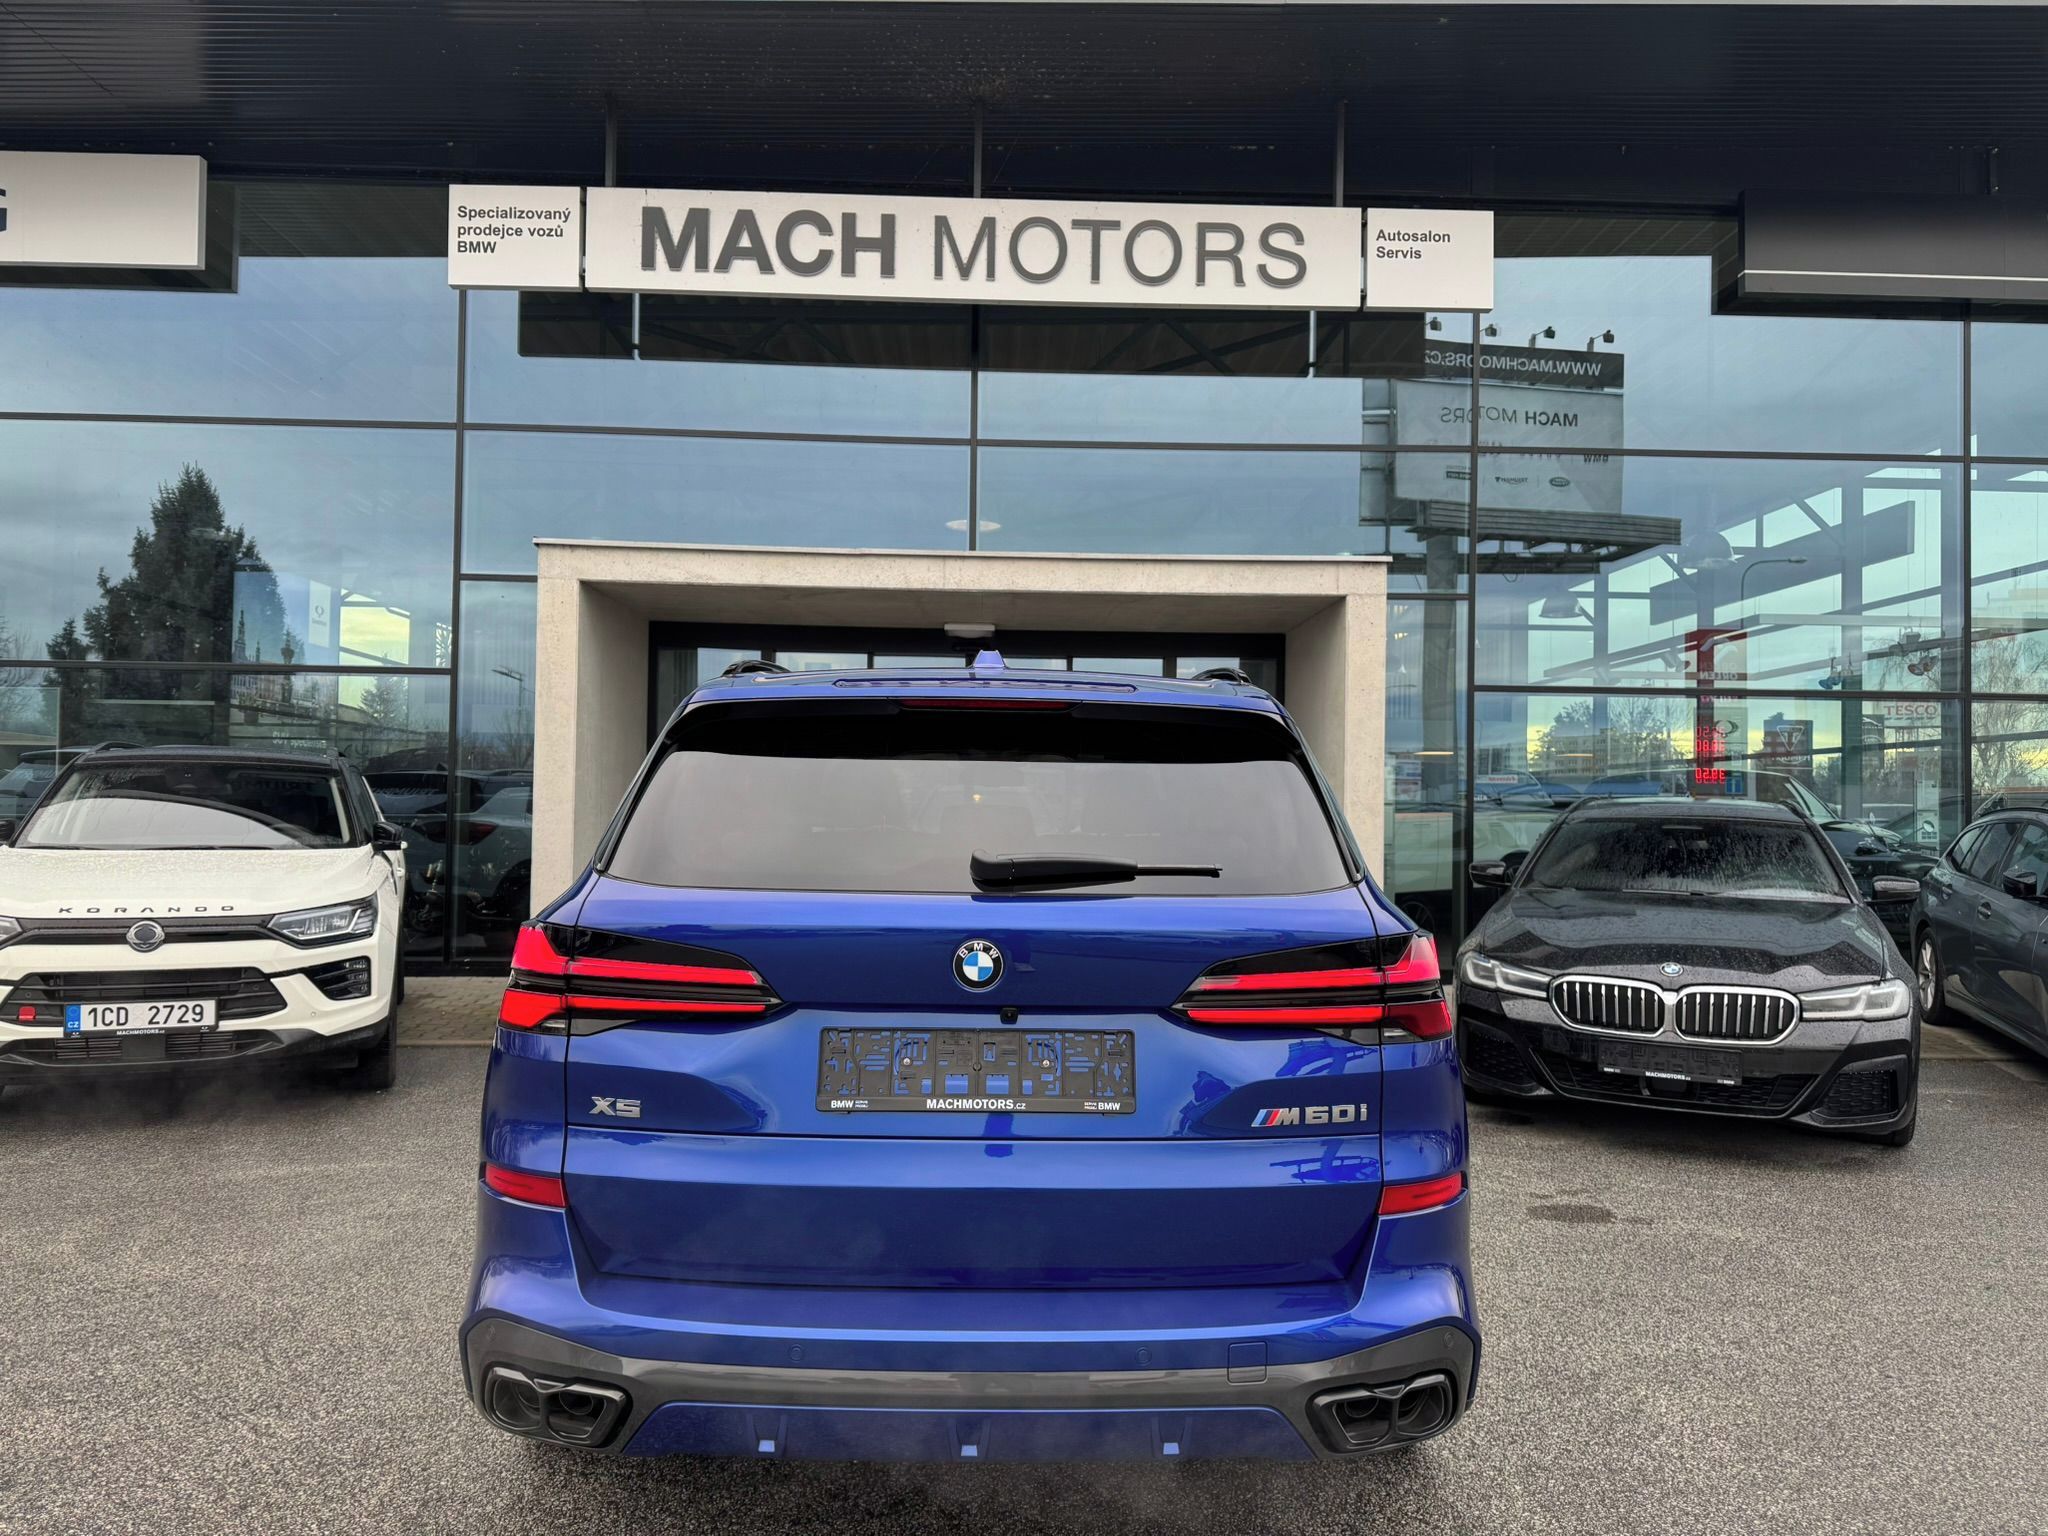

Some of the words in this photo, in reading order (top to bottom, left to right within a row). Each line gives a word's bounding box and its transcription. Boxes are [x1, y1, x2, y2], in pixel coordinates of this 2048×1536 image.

[457, 205, 571, 223] Specializovaný
[457, 224, 523, 239] prodejce
[528, 224, 564, 237] vozů
[1376, 229, 1451, 243] Autosalon
[457, 241, 497, 254] BMW
[640, 206, 896, 277] MACH
[933, 214, 1307, 288] MOTORS
[1376, 246, 1422, 259] Servis
[1883, 704, 1937, 716] TESCO
[58, 905, 234, 914] KORANDO
[958, 943, 999, 959] BMW
[88, 1007, 129, 1027] 1CD
[147, 1003, 205, 1025] 2729
[589, 1096, 641, 1118] X5
[830, 1100, 854, 1109] BMW
[926, 1098, 1026, 1110] MACHMOTORS.cz
[1097, 1102, 1121, 1111] BMW
